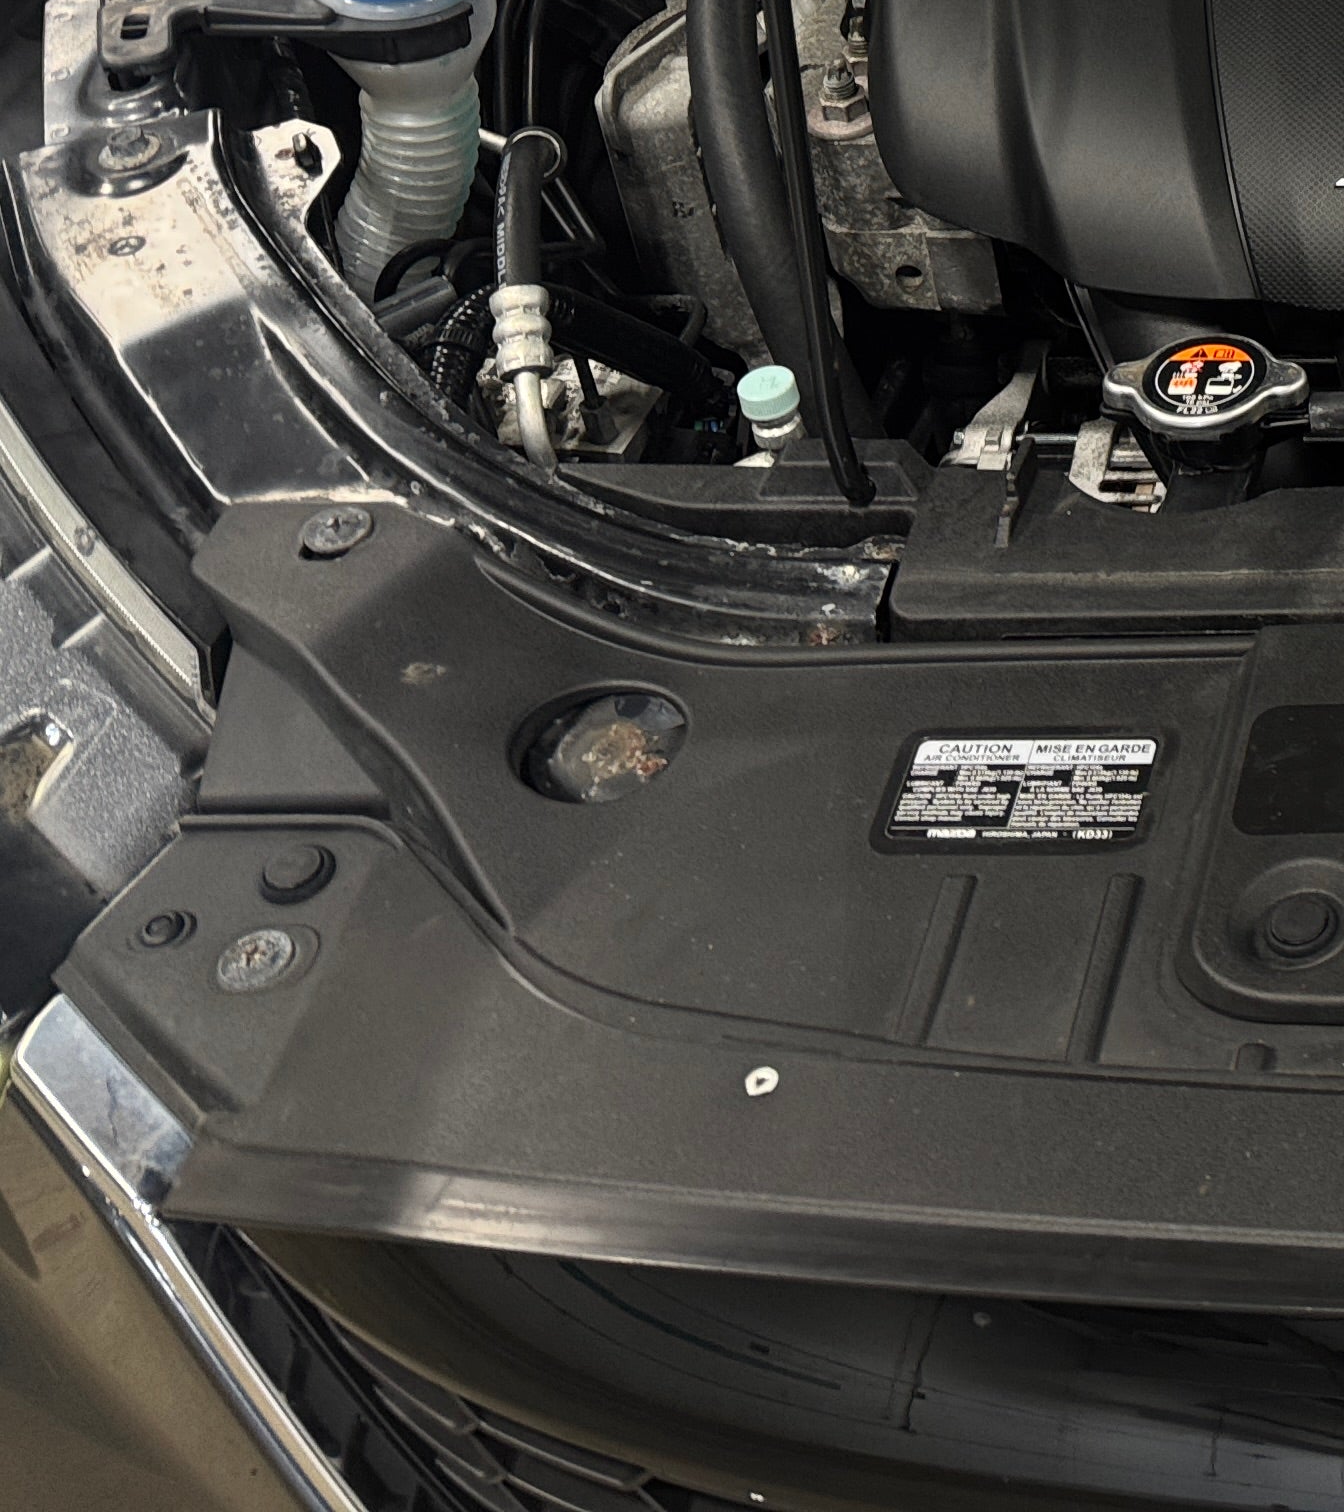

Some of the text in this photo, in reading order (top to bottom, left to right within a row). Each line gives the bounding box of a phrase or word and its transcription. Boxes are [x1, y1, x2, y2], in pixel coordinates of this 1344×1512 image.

[939, 743, 1013, 754] CAUTION
[1036, 743, 1152, 754] MISE EN GARDE
[924, 754, 1020, 762] AIR CONDITIONER
[1053, 754, 1127, 762] CLIMATISEUR
[926, 828, 977, 839] mazda
[1072, 829, 1113, 840] (KD33)
